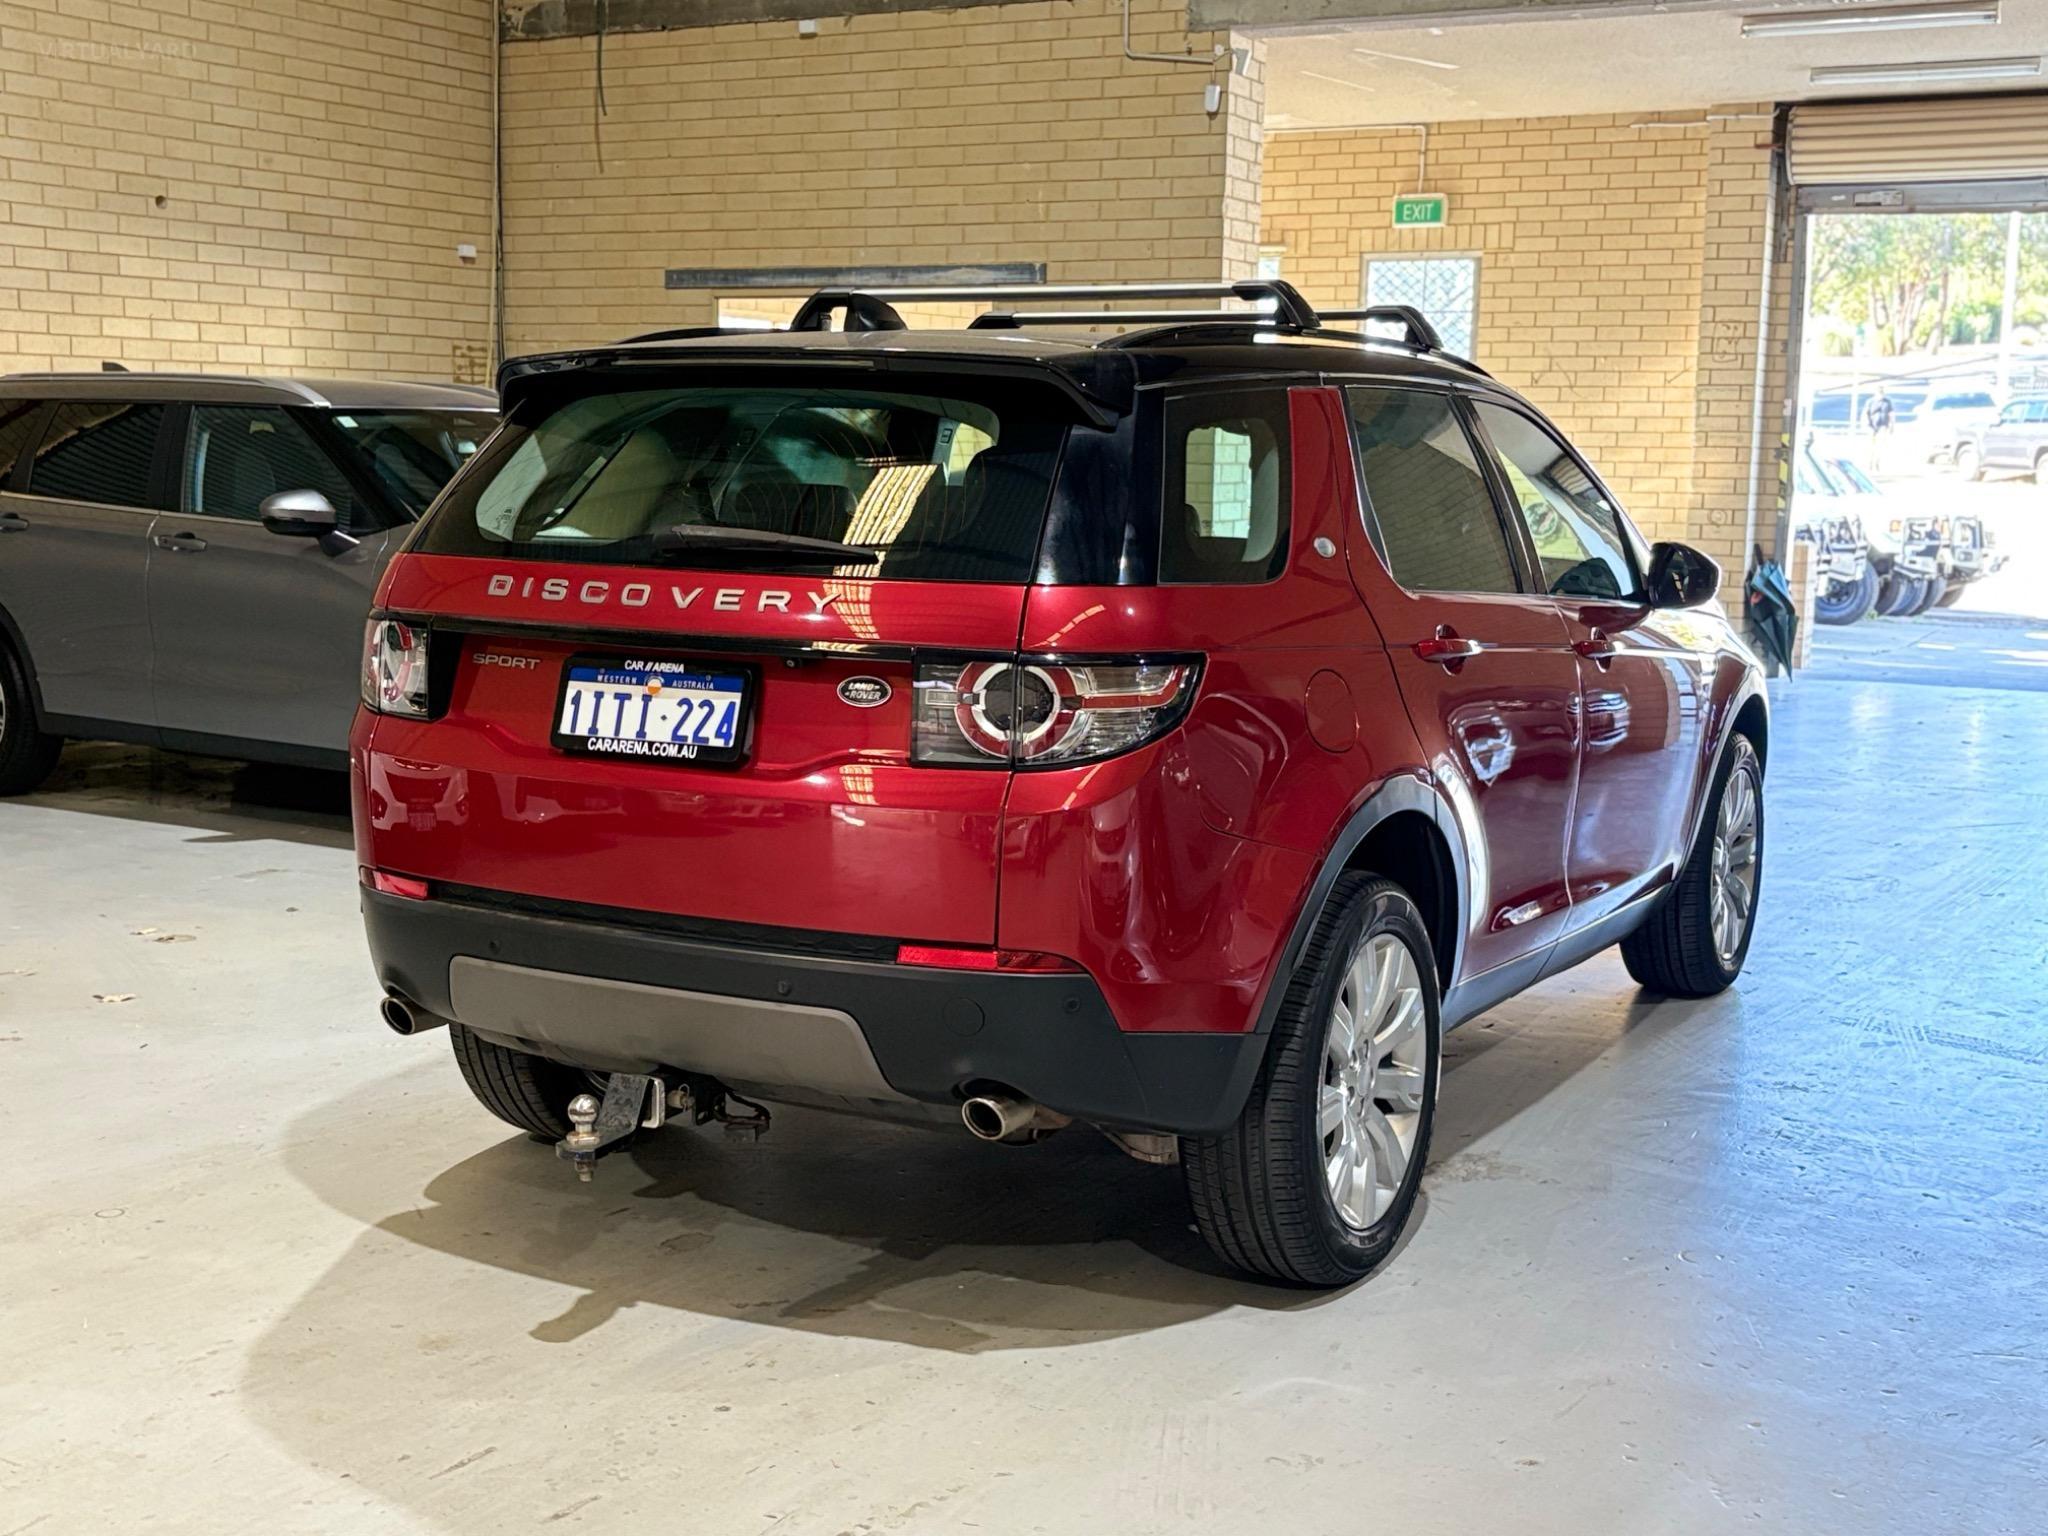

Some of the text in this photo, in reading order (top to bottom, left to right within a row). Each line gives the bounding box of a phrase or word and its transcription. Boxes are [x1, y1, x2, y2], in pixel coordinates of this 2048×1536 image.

[1402, 203, 1435, 221] EXIT
[487, 574, 842, 614] DISCOVERY
[472, 652, 541, 670] SPORT
[597, 674, 715, 690] WESTERN AUSTRALIA
[587, 737, 698, 759] CARARENA.COM.AU
